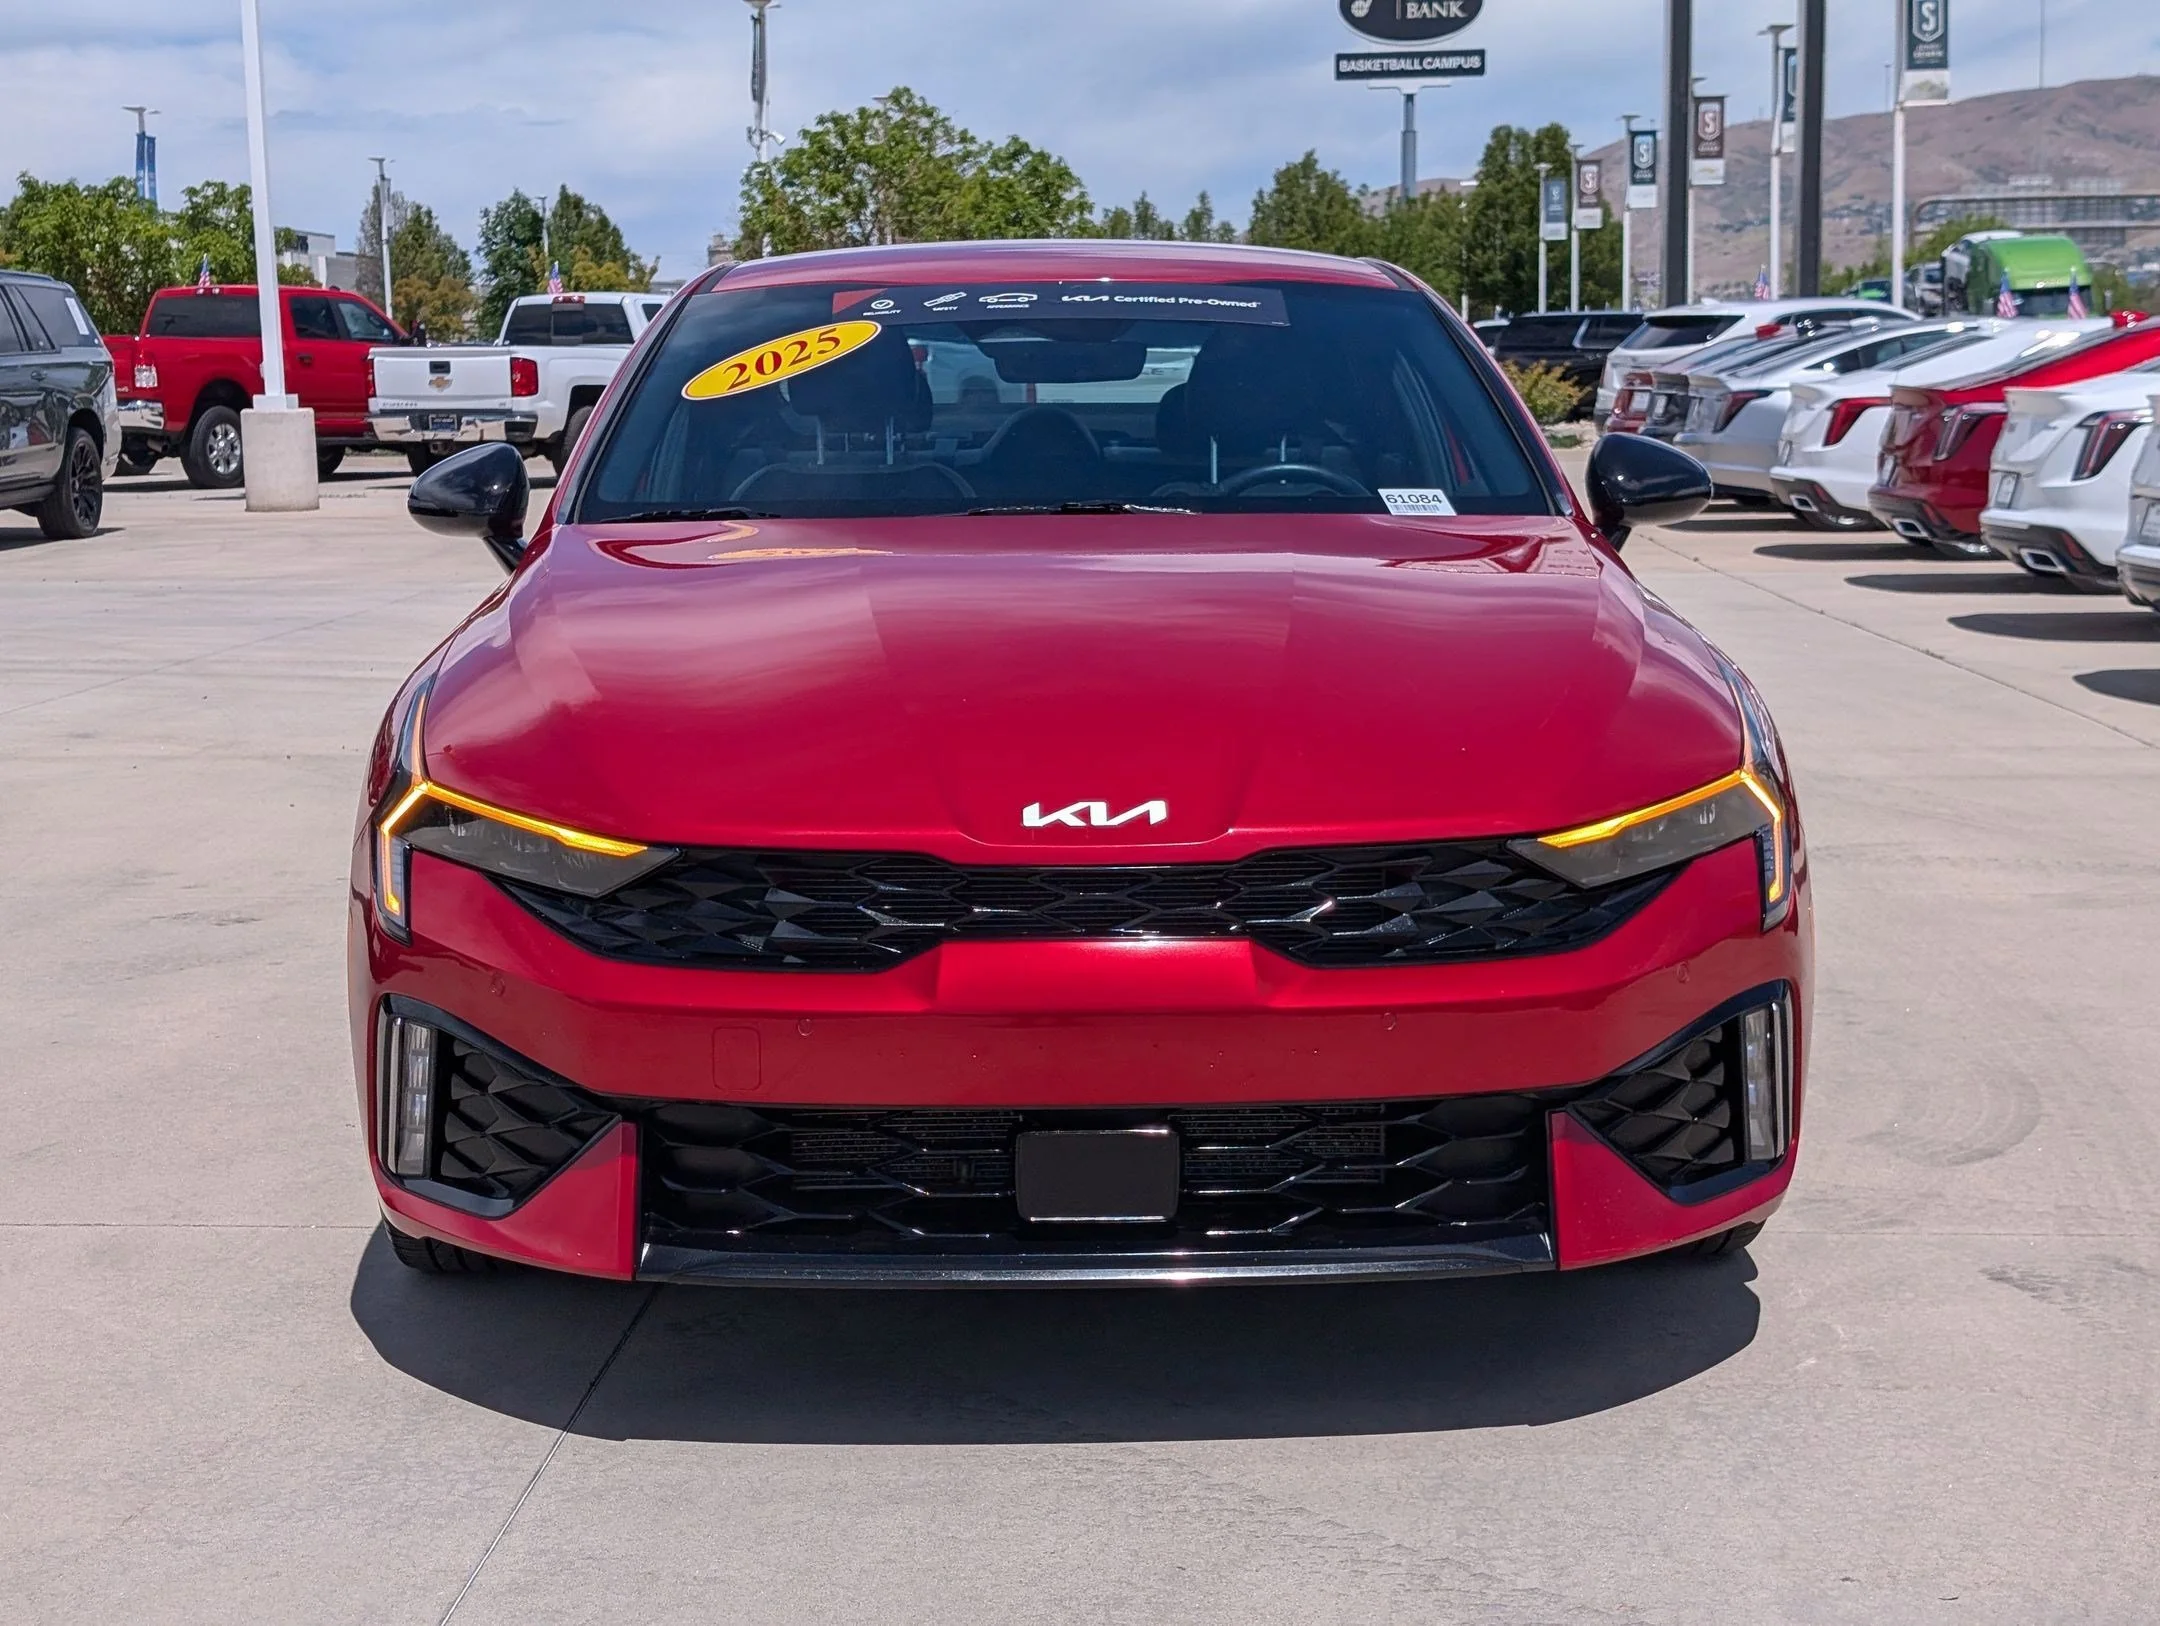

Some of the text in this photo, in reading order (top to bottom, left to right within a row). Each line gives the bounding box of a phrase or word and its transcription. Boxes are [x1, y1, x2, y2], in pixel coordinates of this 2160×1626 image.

[1405, 2, 1468, 19] BANK
[1921, 1, 1937, 32] S
[1338, 55, 1482, 72] BASKETBALL CAMPUS
[1113, 295, 1176, 304] Certified
[723, 327, 841, 391] 2025
[1385, 494, 1443, 504] 61084
[1022, 800, 1167, 827] KIA
